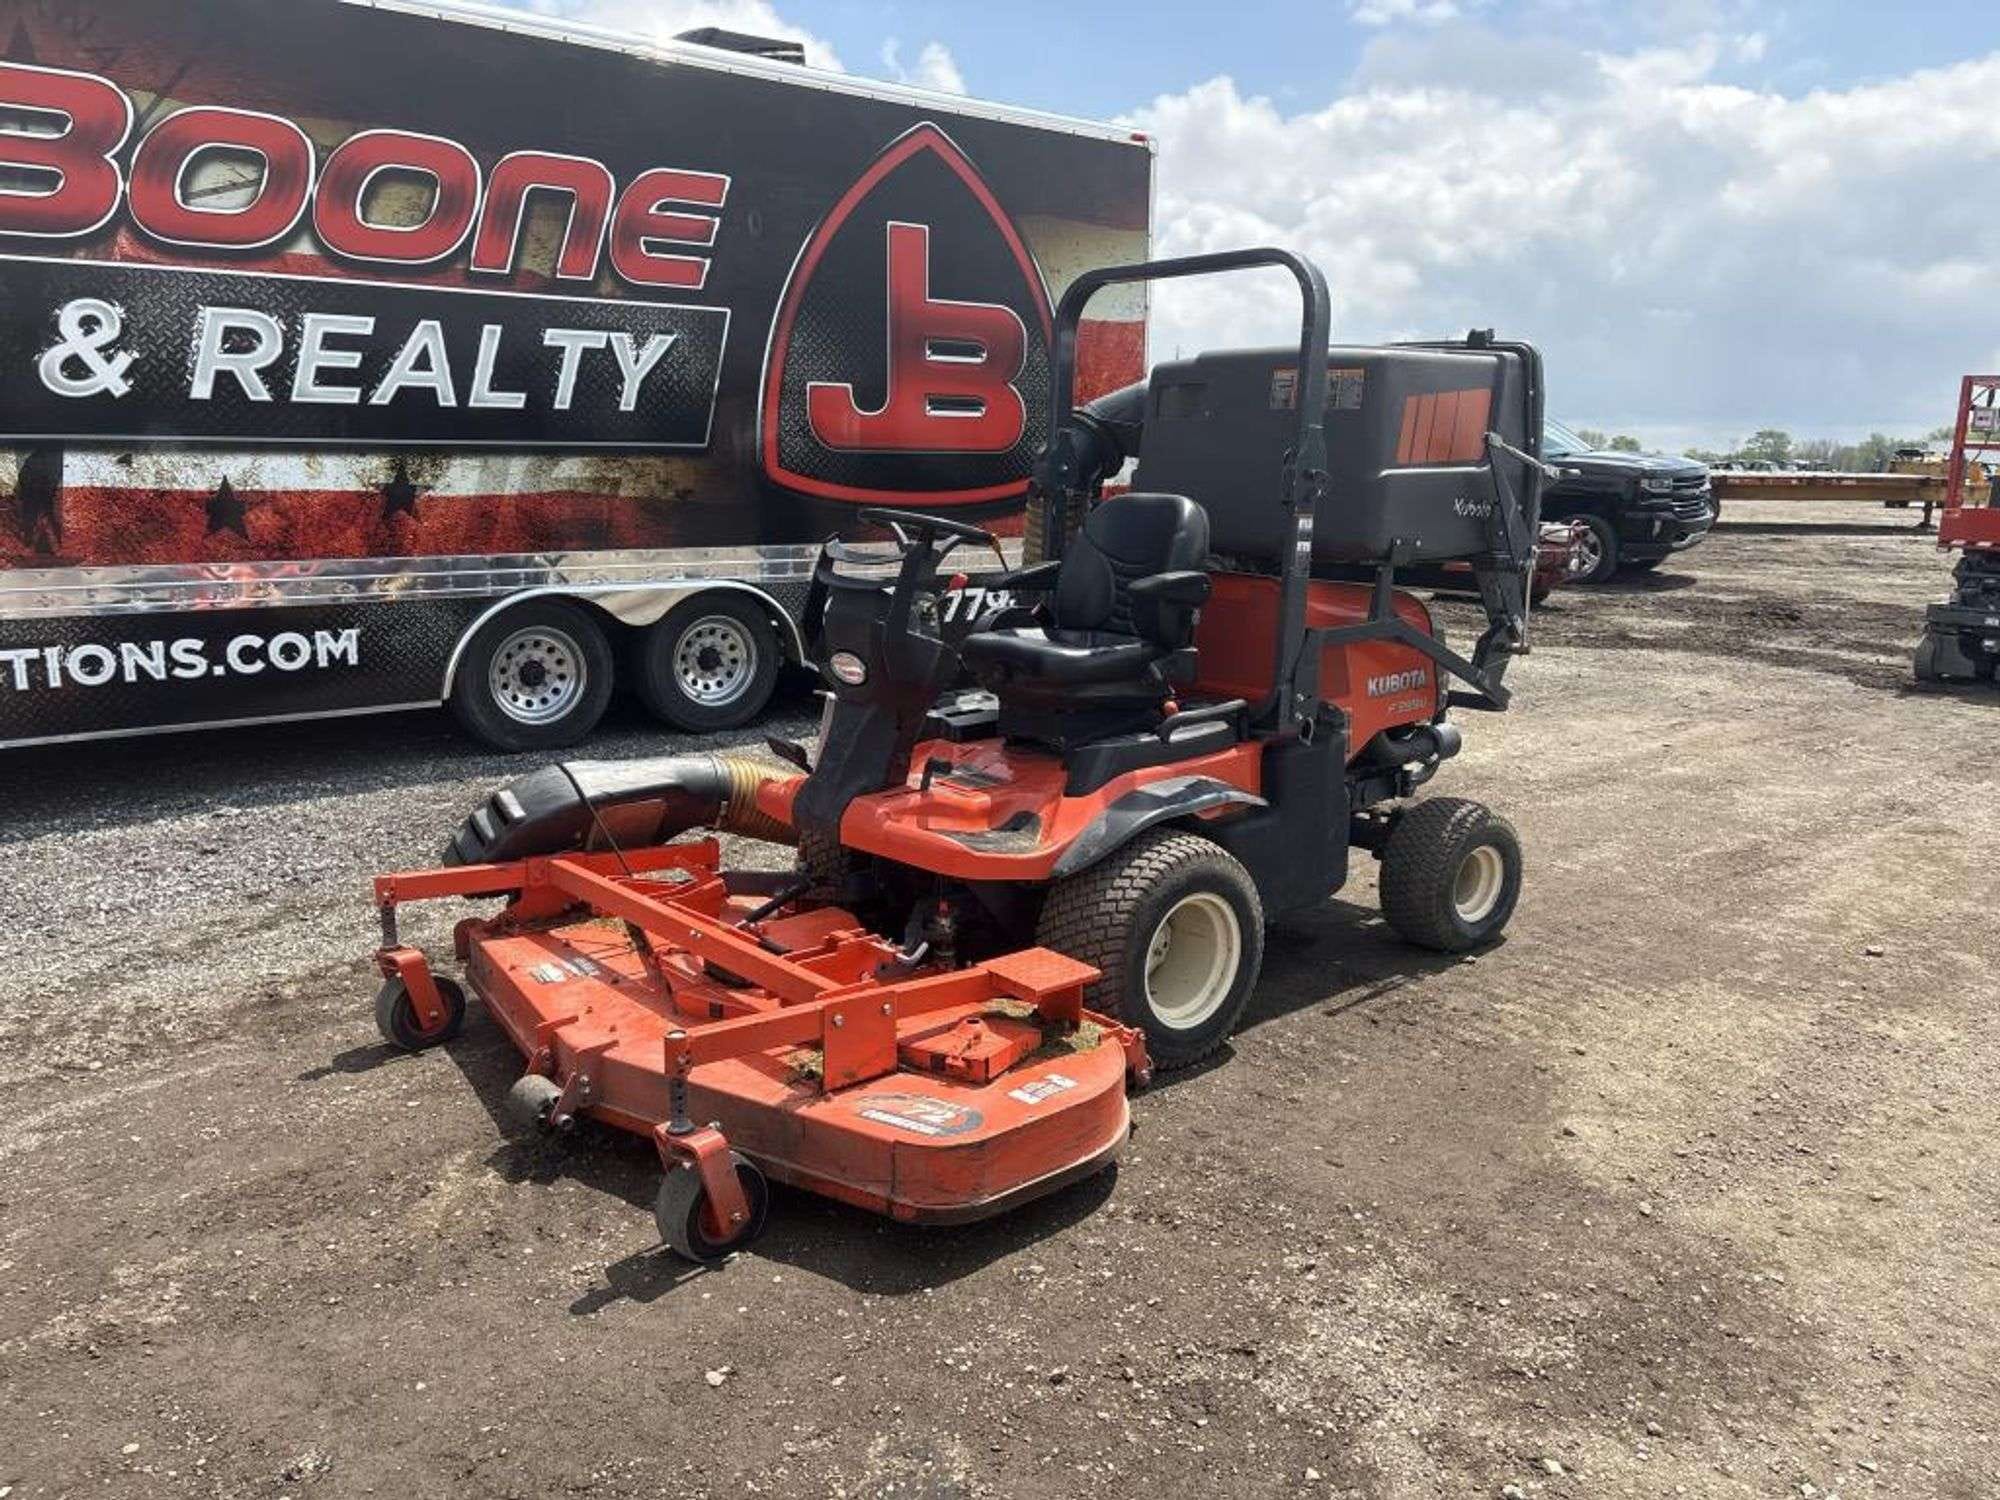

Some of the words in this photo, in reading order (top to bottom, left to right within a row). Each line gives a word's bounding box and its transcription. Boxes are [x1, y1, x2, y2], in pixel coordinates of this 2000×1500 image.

[0, 61, 731, 290] BOONE
[37, 296, 139, 400] &
[188, 304, 679, 413] REALTY
[1366, 669, 1426, 698] KUBOTA
